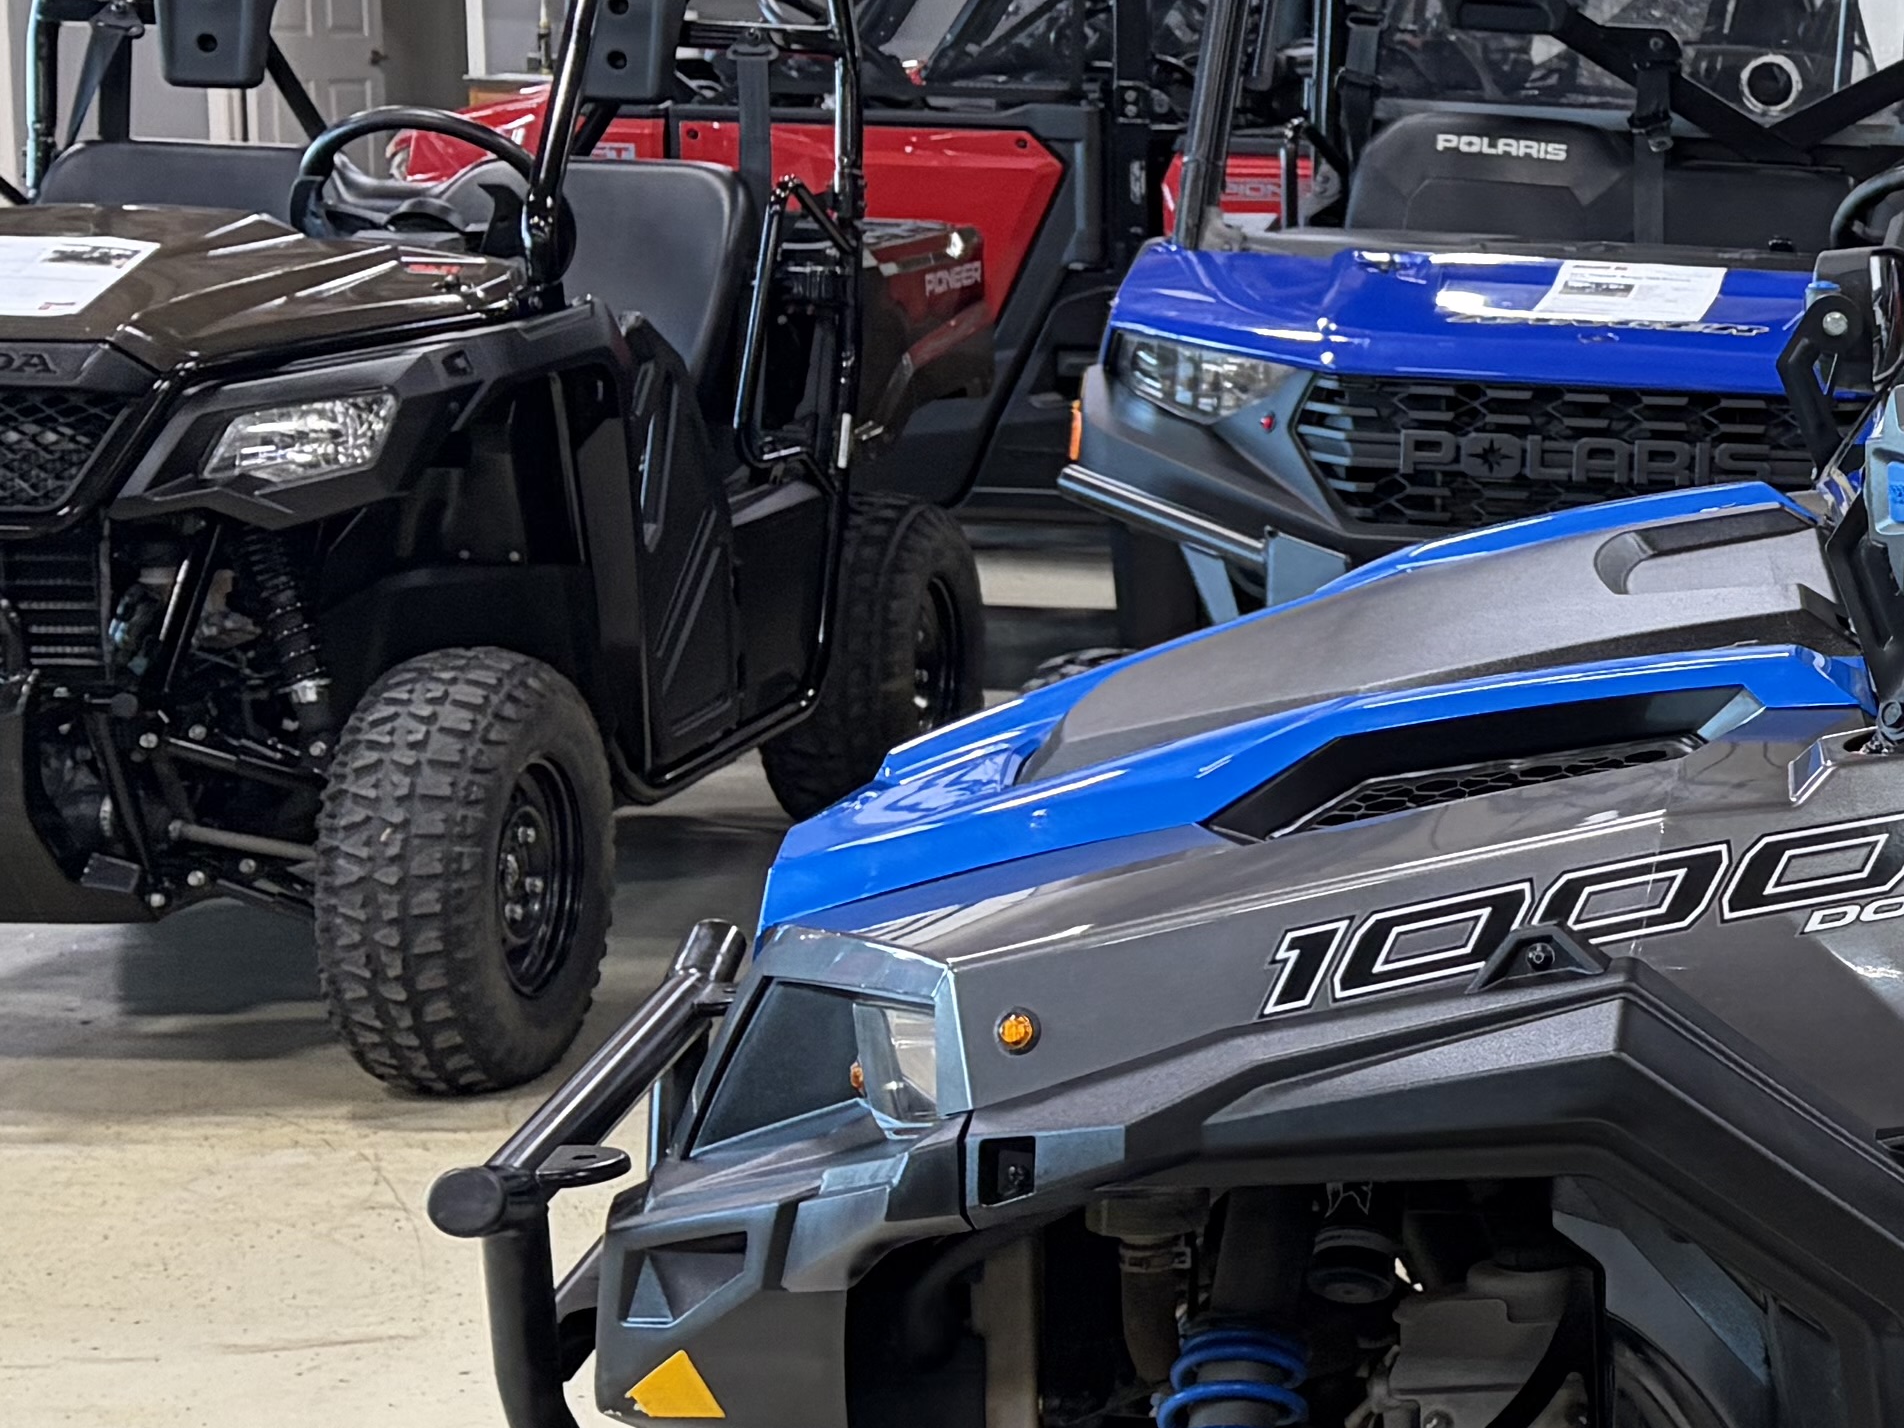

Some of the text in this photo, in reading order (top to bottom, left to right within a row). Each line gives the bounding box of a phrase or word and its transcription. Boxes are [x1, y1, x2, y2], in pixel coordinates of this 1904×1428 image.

[1435, 133, 1569, 161] POLARIS
[924, 261, 983, 296] PIONEER
[1400, 428, 1771, 486] POLARIS
